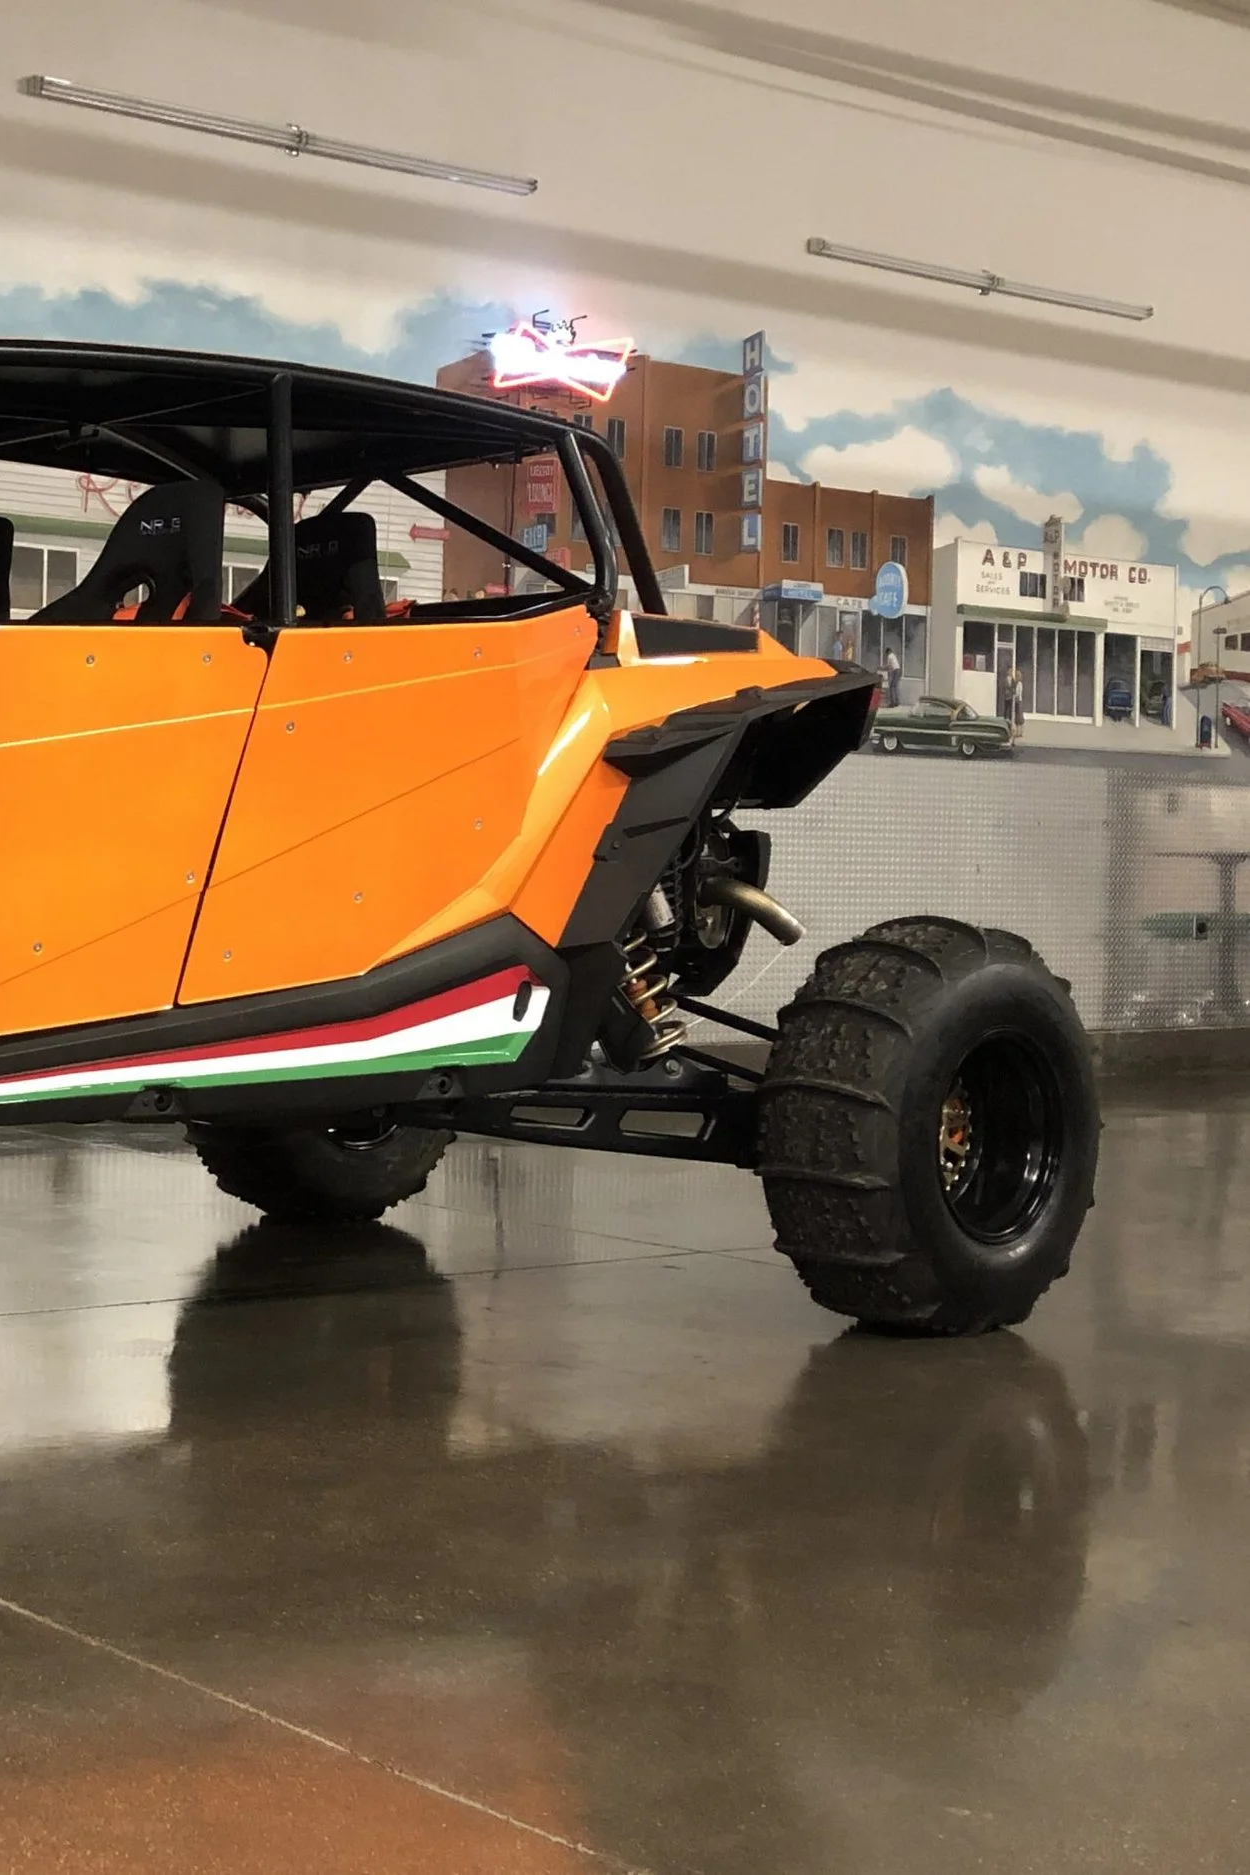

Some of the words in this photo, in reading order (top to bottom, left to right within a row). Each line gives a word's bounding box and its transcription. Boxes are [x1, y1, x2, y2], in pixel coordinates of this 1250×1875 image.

[743, 337, 761, 547] HOTEL
[981, 571, 1003, 581] SALES
[982, 549, 995, 566] A
[1002, 552, 1012, 568] &
[1063, 559, 1118, 581] MOTOR
[1128, 566, 1151, 584] CO.
[976, 584, 1011, 596] SERVICES
